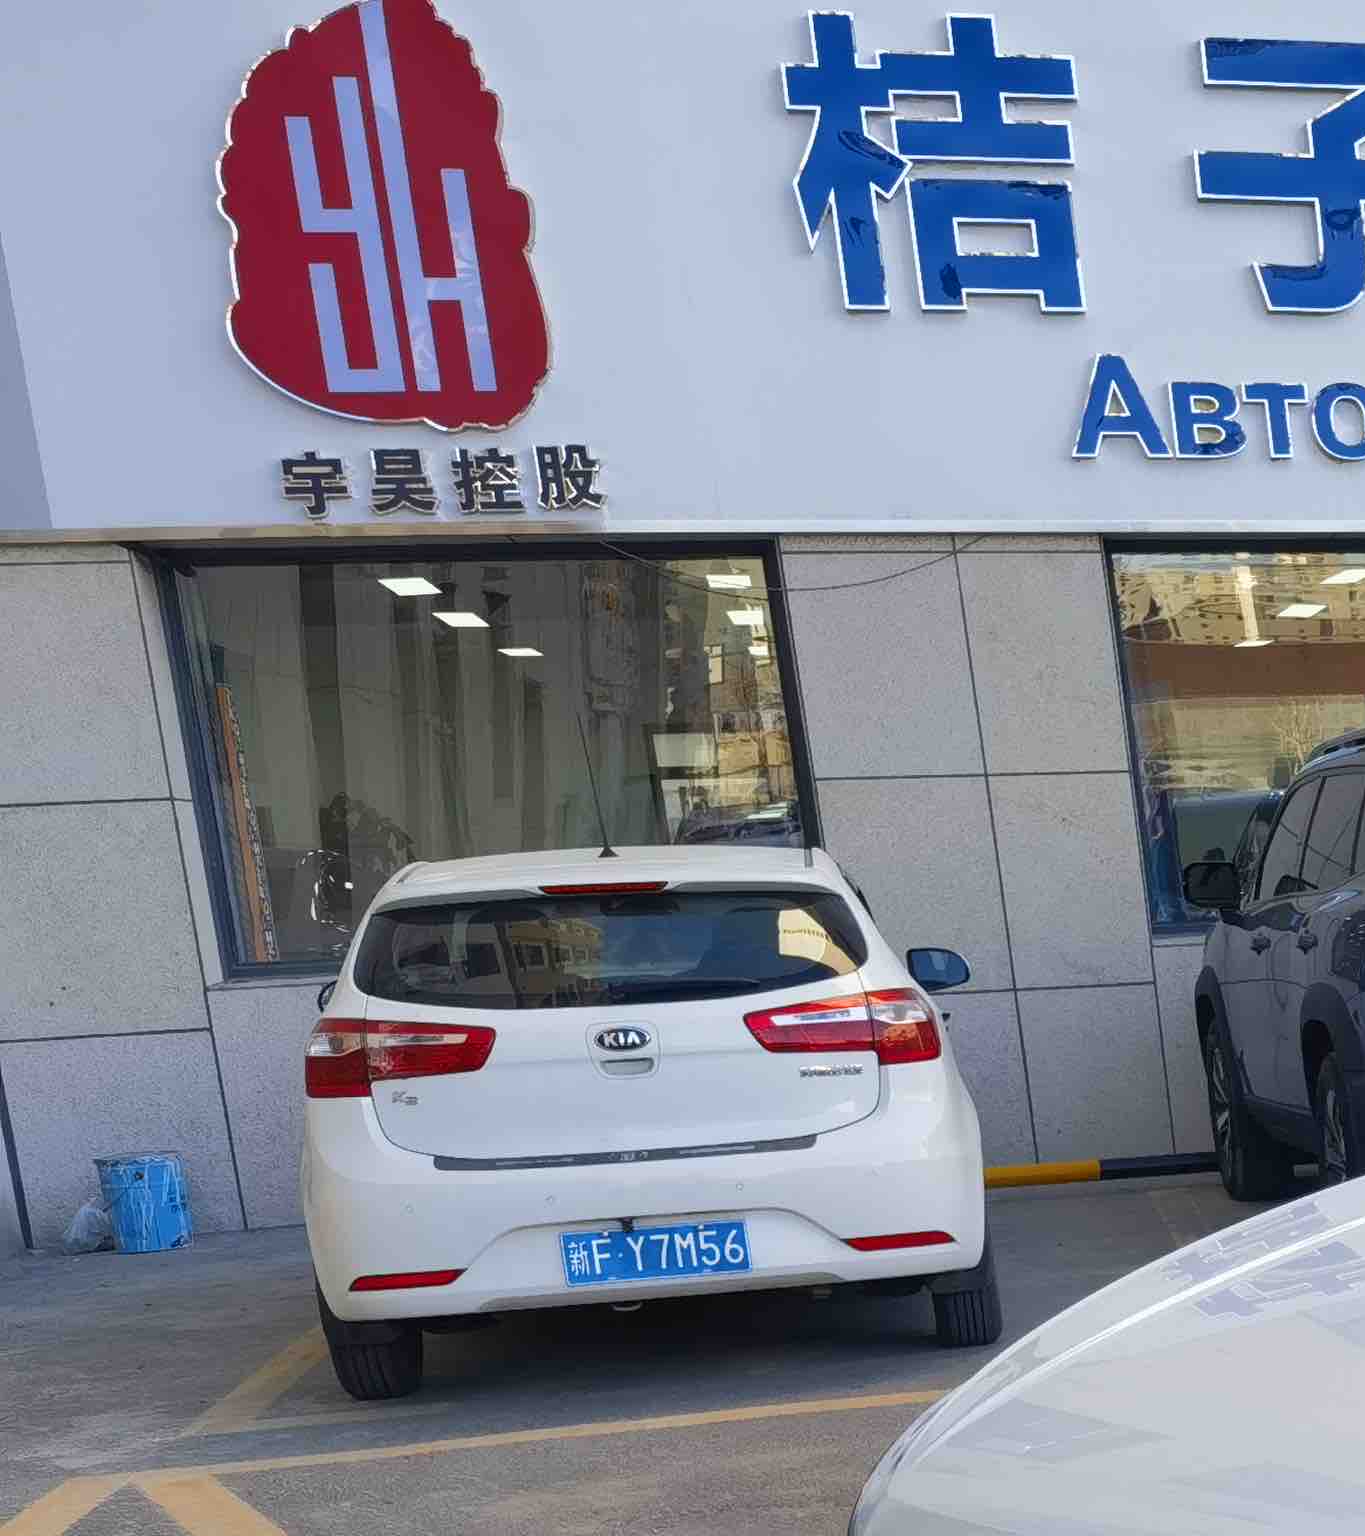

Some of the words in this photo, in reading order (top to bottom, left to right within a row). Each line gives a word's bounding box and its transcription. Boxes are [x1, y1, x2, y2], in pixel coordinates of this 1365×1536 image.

[280, 443, 608, 519] 宇昊控股
[603, 1031, 641, 1048] KIA
